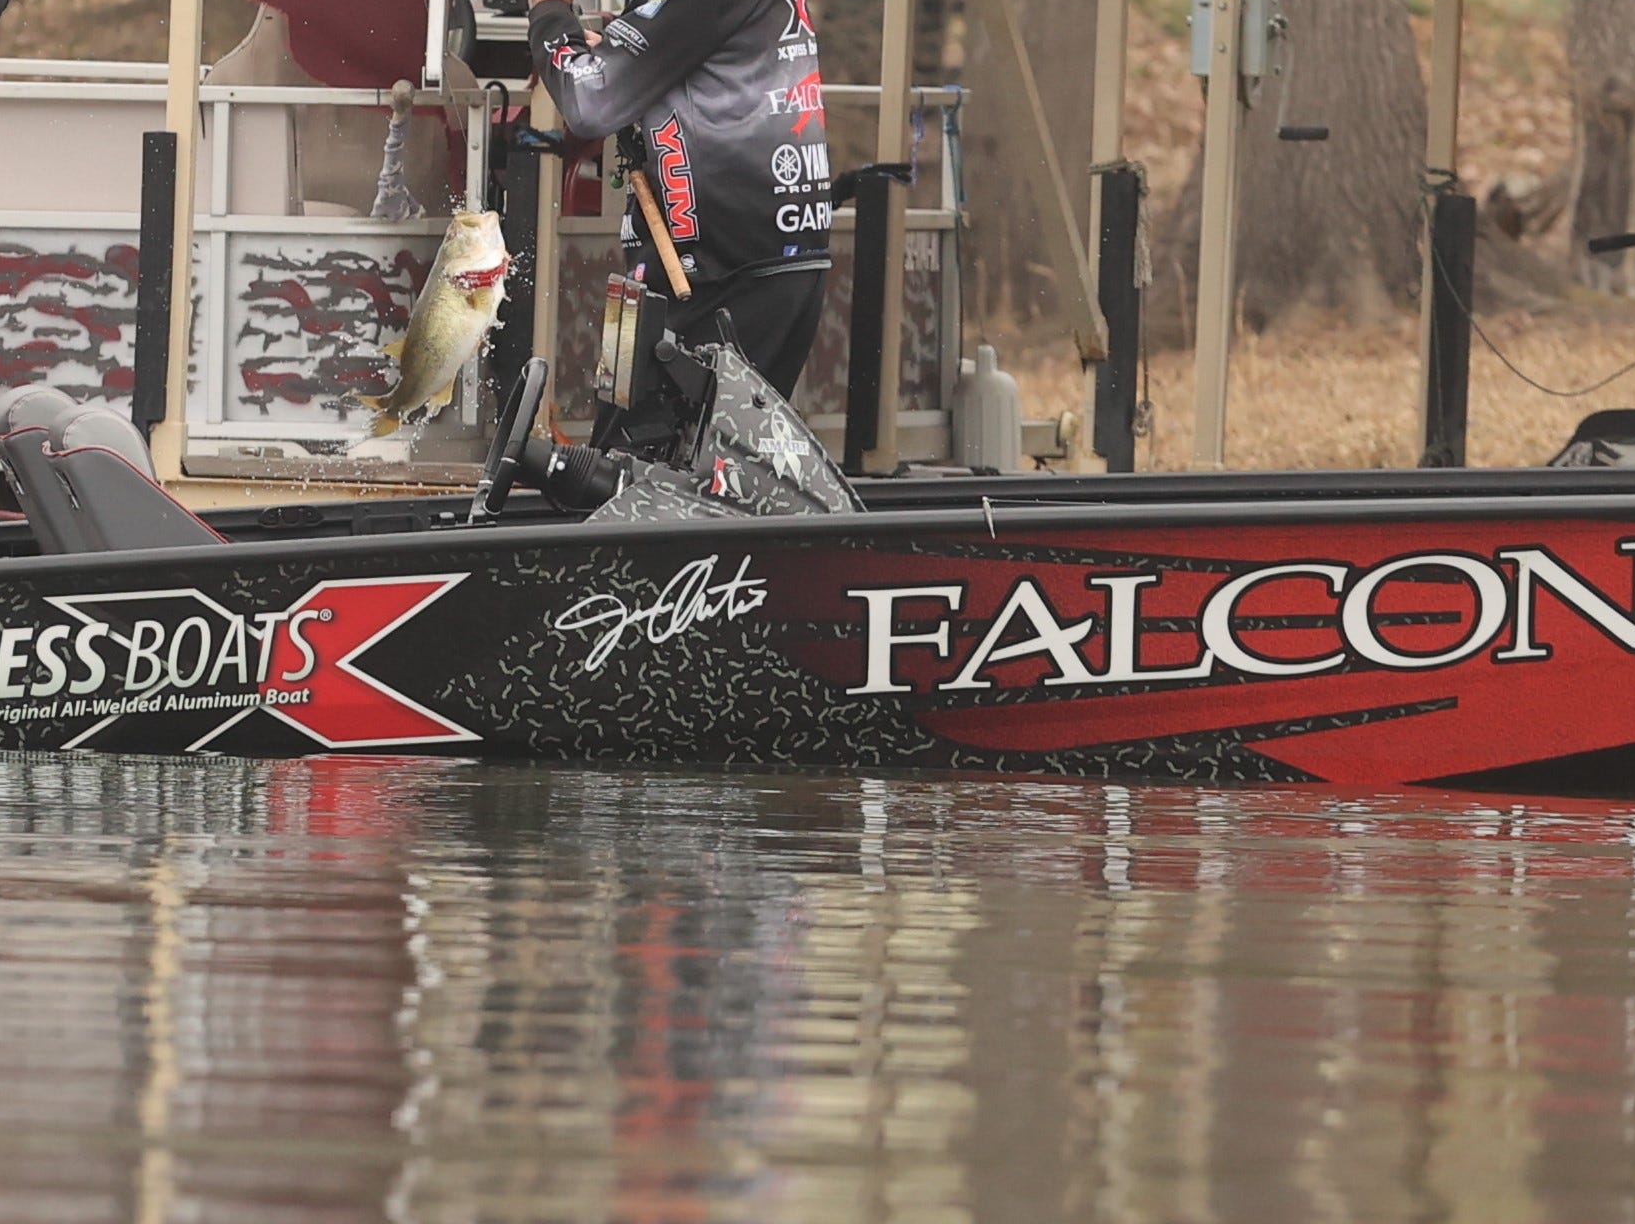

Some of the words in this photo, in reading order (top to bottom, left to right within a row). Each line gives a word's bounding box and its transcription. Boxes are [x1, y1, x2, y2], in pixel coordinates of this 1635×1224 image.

[651, 111, 698, 241] YUM
[774, 184, 812, 195] PRO
[123, 609, 319, 691] BOATS
[60, 695, 163, 718] All-Welded
[164, 692, 262, 712] Aluminum
[265, 688, 311, 706] Boat
